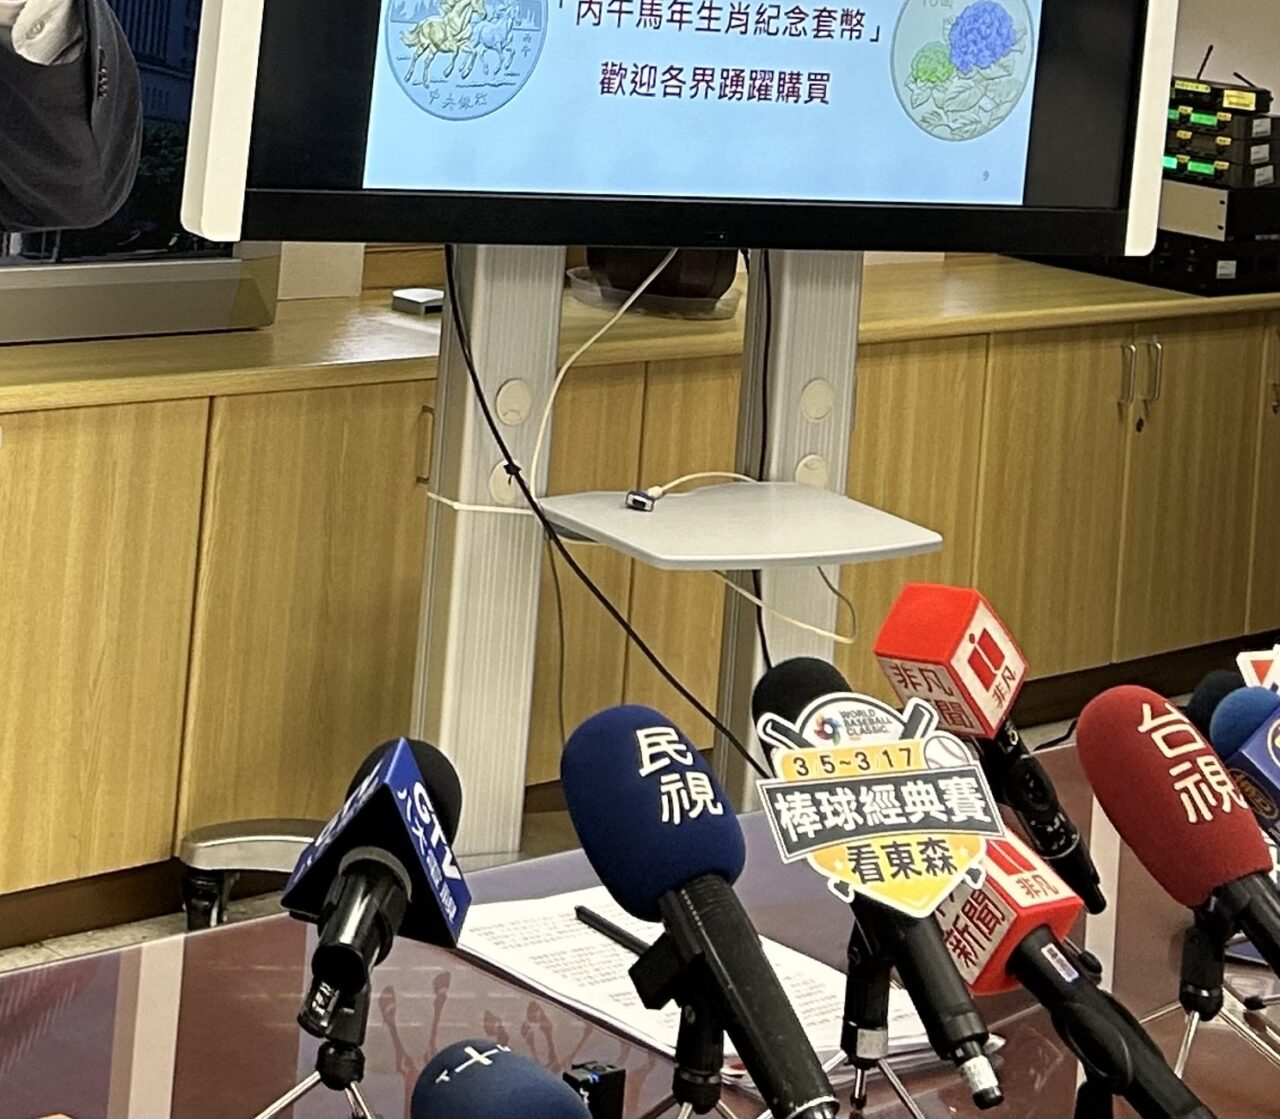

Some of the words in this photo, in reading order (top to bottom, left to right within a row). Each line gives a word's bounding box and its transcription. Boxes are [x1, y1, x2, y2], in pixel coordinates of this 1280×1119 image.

[599, 61, 831, 105] 歡迎各界踴躍購買
[982, 170, 990, 181] 9
[889, 663, 954, 697] 非凡
[992, 665, 1016, 709] 非凡
[839, 709, 876, 718] WORLD
[843, 717, 893, 728] BASEBALL
[923, 697, 974, 729] 聞
[636, 726, 724, 825] 民視
[1137, 702, 1248, 823] 台視
[413, 781, 462, 880] GTV
[774, 776, 992, 842] 棒球經典賽
[847, 837, 958, 885] 看東森
[1016, 874, 1059, 898] 非凡
[944, 889, 1006, 969] 新聞
